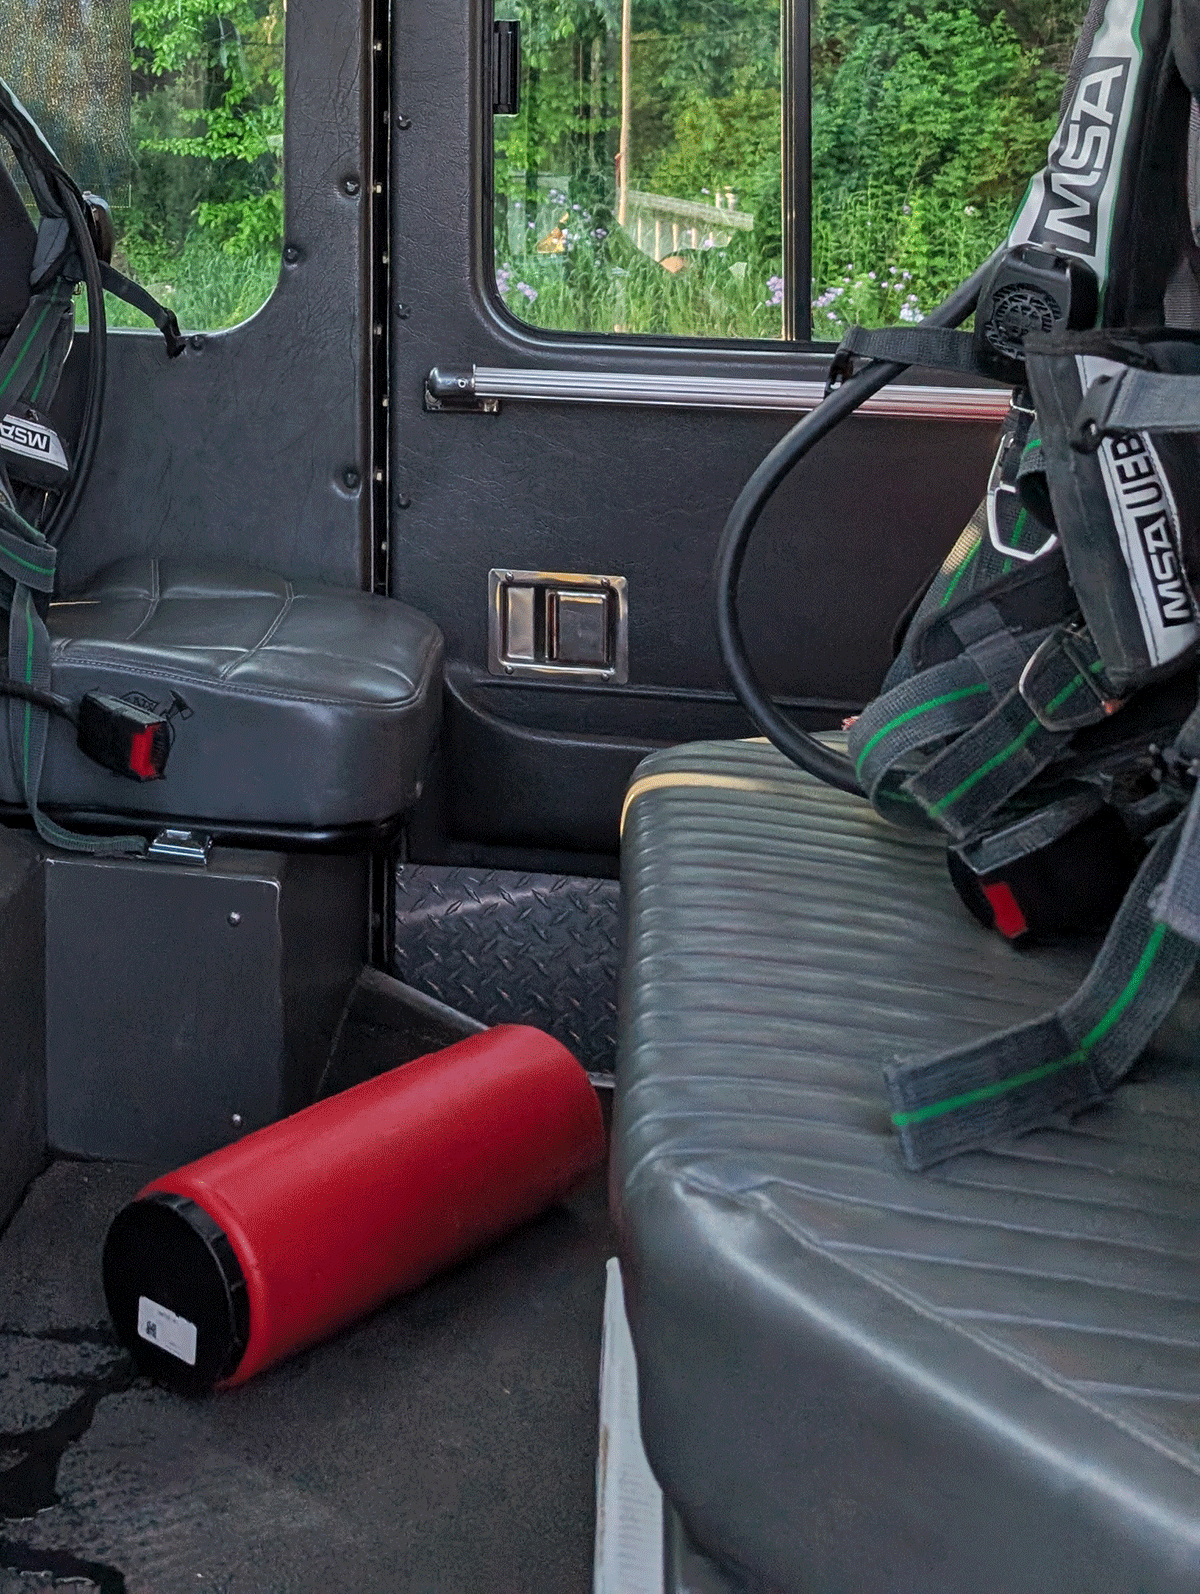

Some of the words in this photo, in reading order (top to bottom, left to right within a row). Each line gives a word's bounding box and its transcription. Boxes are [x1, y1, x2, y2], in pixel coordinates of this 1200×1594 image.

[1044, 64, 1124, 244] MSA
[0, 422, 48, 450] MSA
[1143, 516, 1191, 620] MSA
